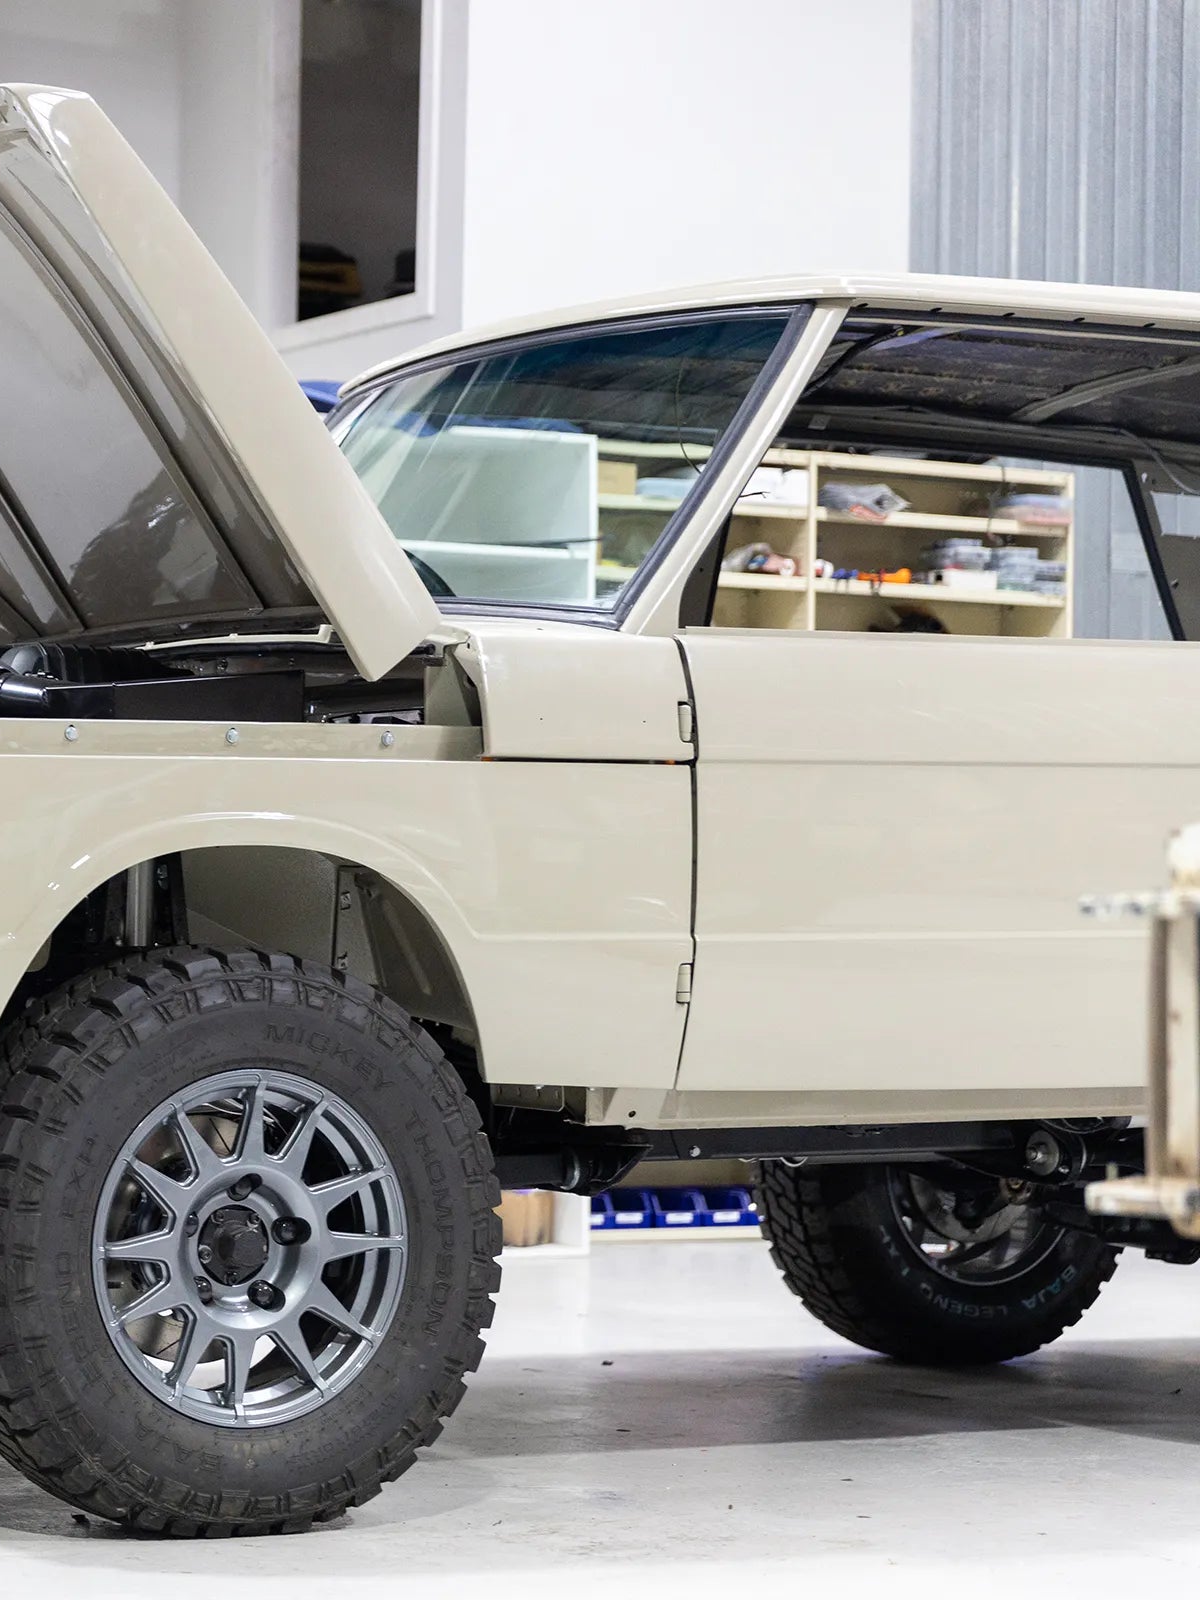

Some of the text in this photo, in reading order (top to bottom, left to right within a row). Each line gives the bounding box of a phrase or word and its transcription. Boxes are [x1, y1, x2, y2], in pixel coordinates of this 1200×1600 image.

[266, 1023, 454, 1338] MICKEY THOMPSON
[919, 1281, 1009, 1319] LEGEND
[1022, 1264, 1076, 1310] BAJA
[133, 1424, 220, 1472] BAJA
